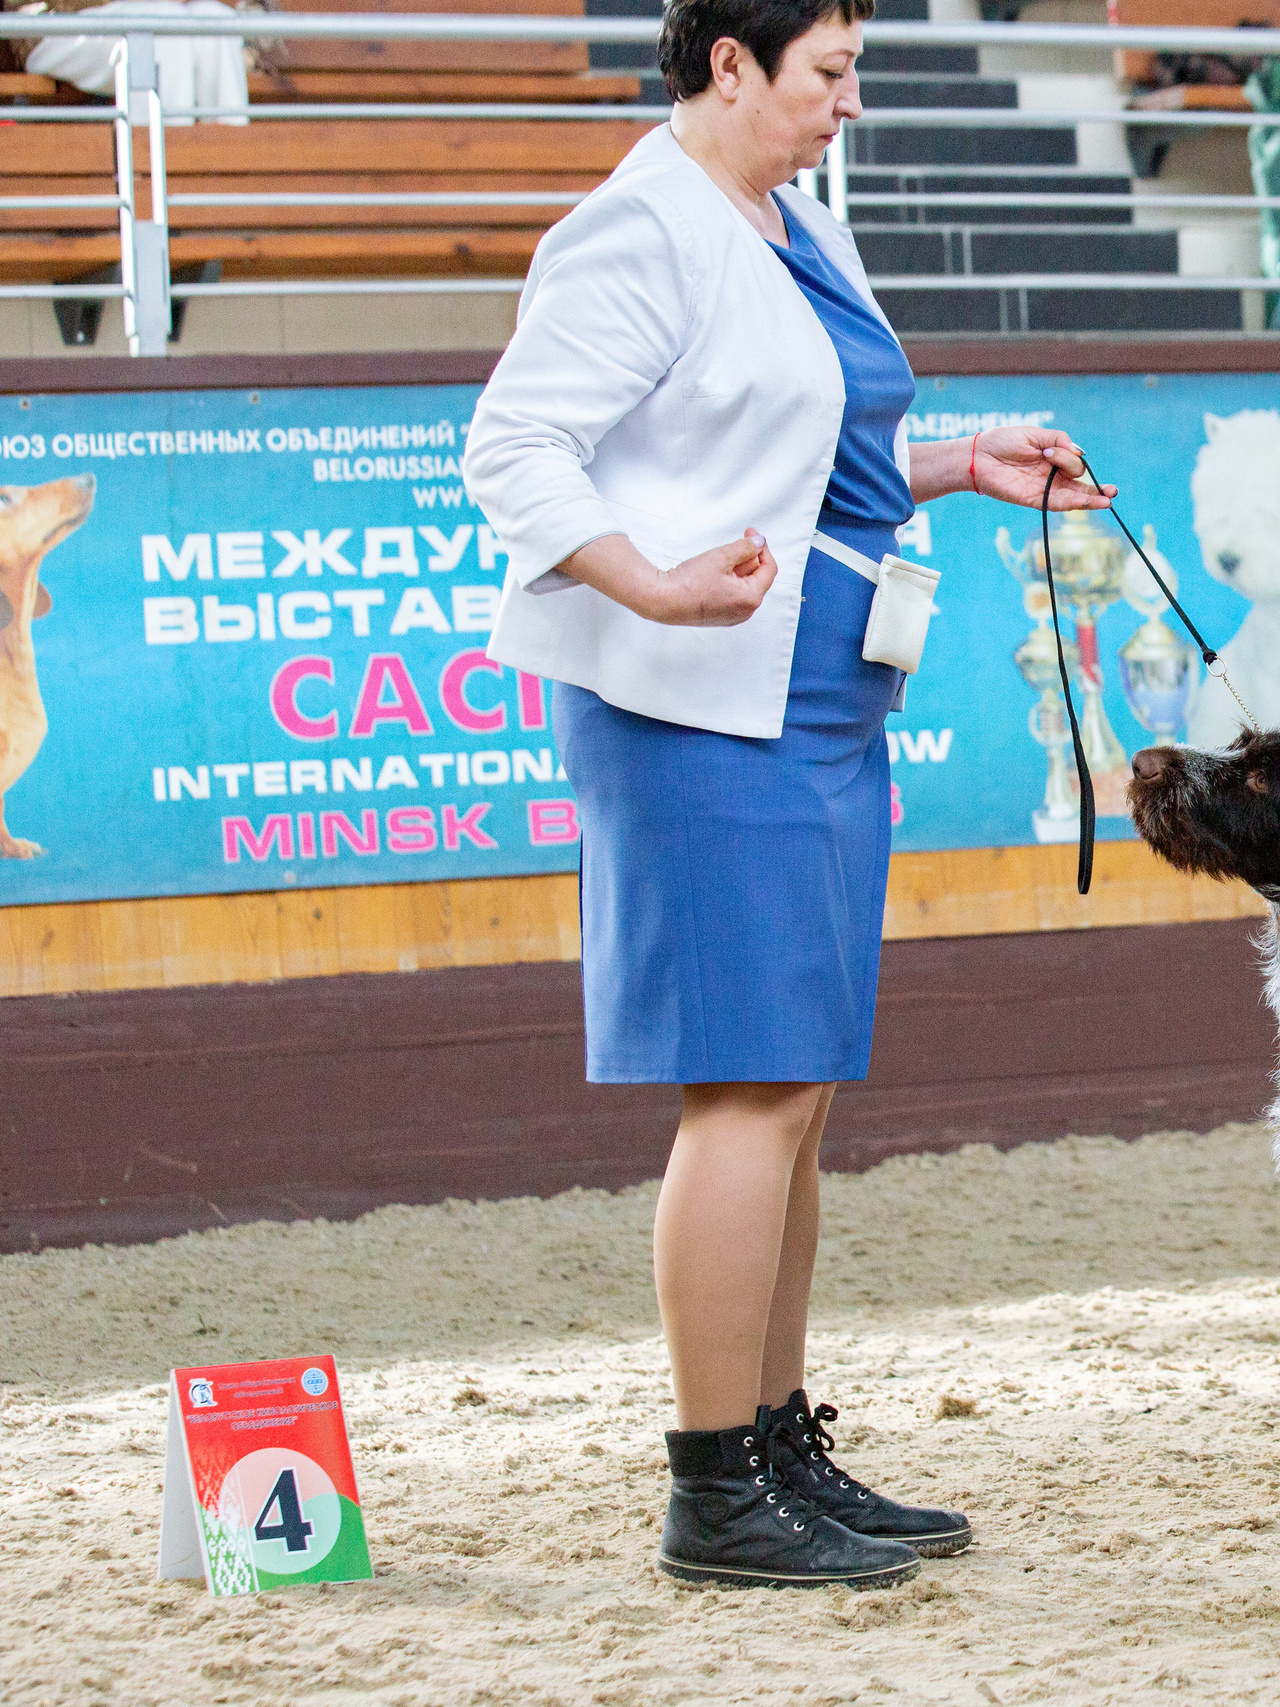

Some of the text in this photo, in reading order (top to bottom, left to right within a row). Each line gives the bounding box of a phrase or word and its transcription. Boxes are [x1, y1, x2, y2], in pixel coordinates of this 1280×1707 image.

[0, 419, 456, 460] ЮЗ ОБЩЕСТВЕННЫХ ОБЪЕДИНЕНИЙ
[222, 803, 499, 863] MINSK
[253, 1466, 316, 1556] 4
